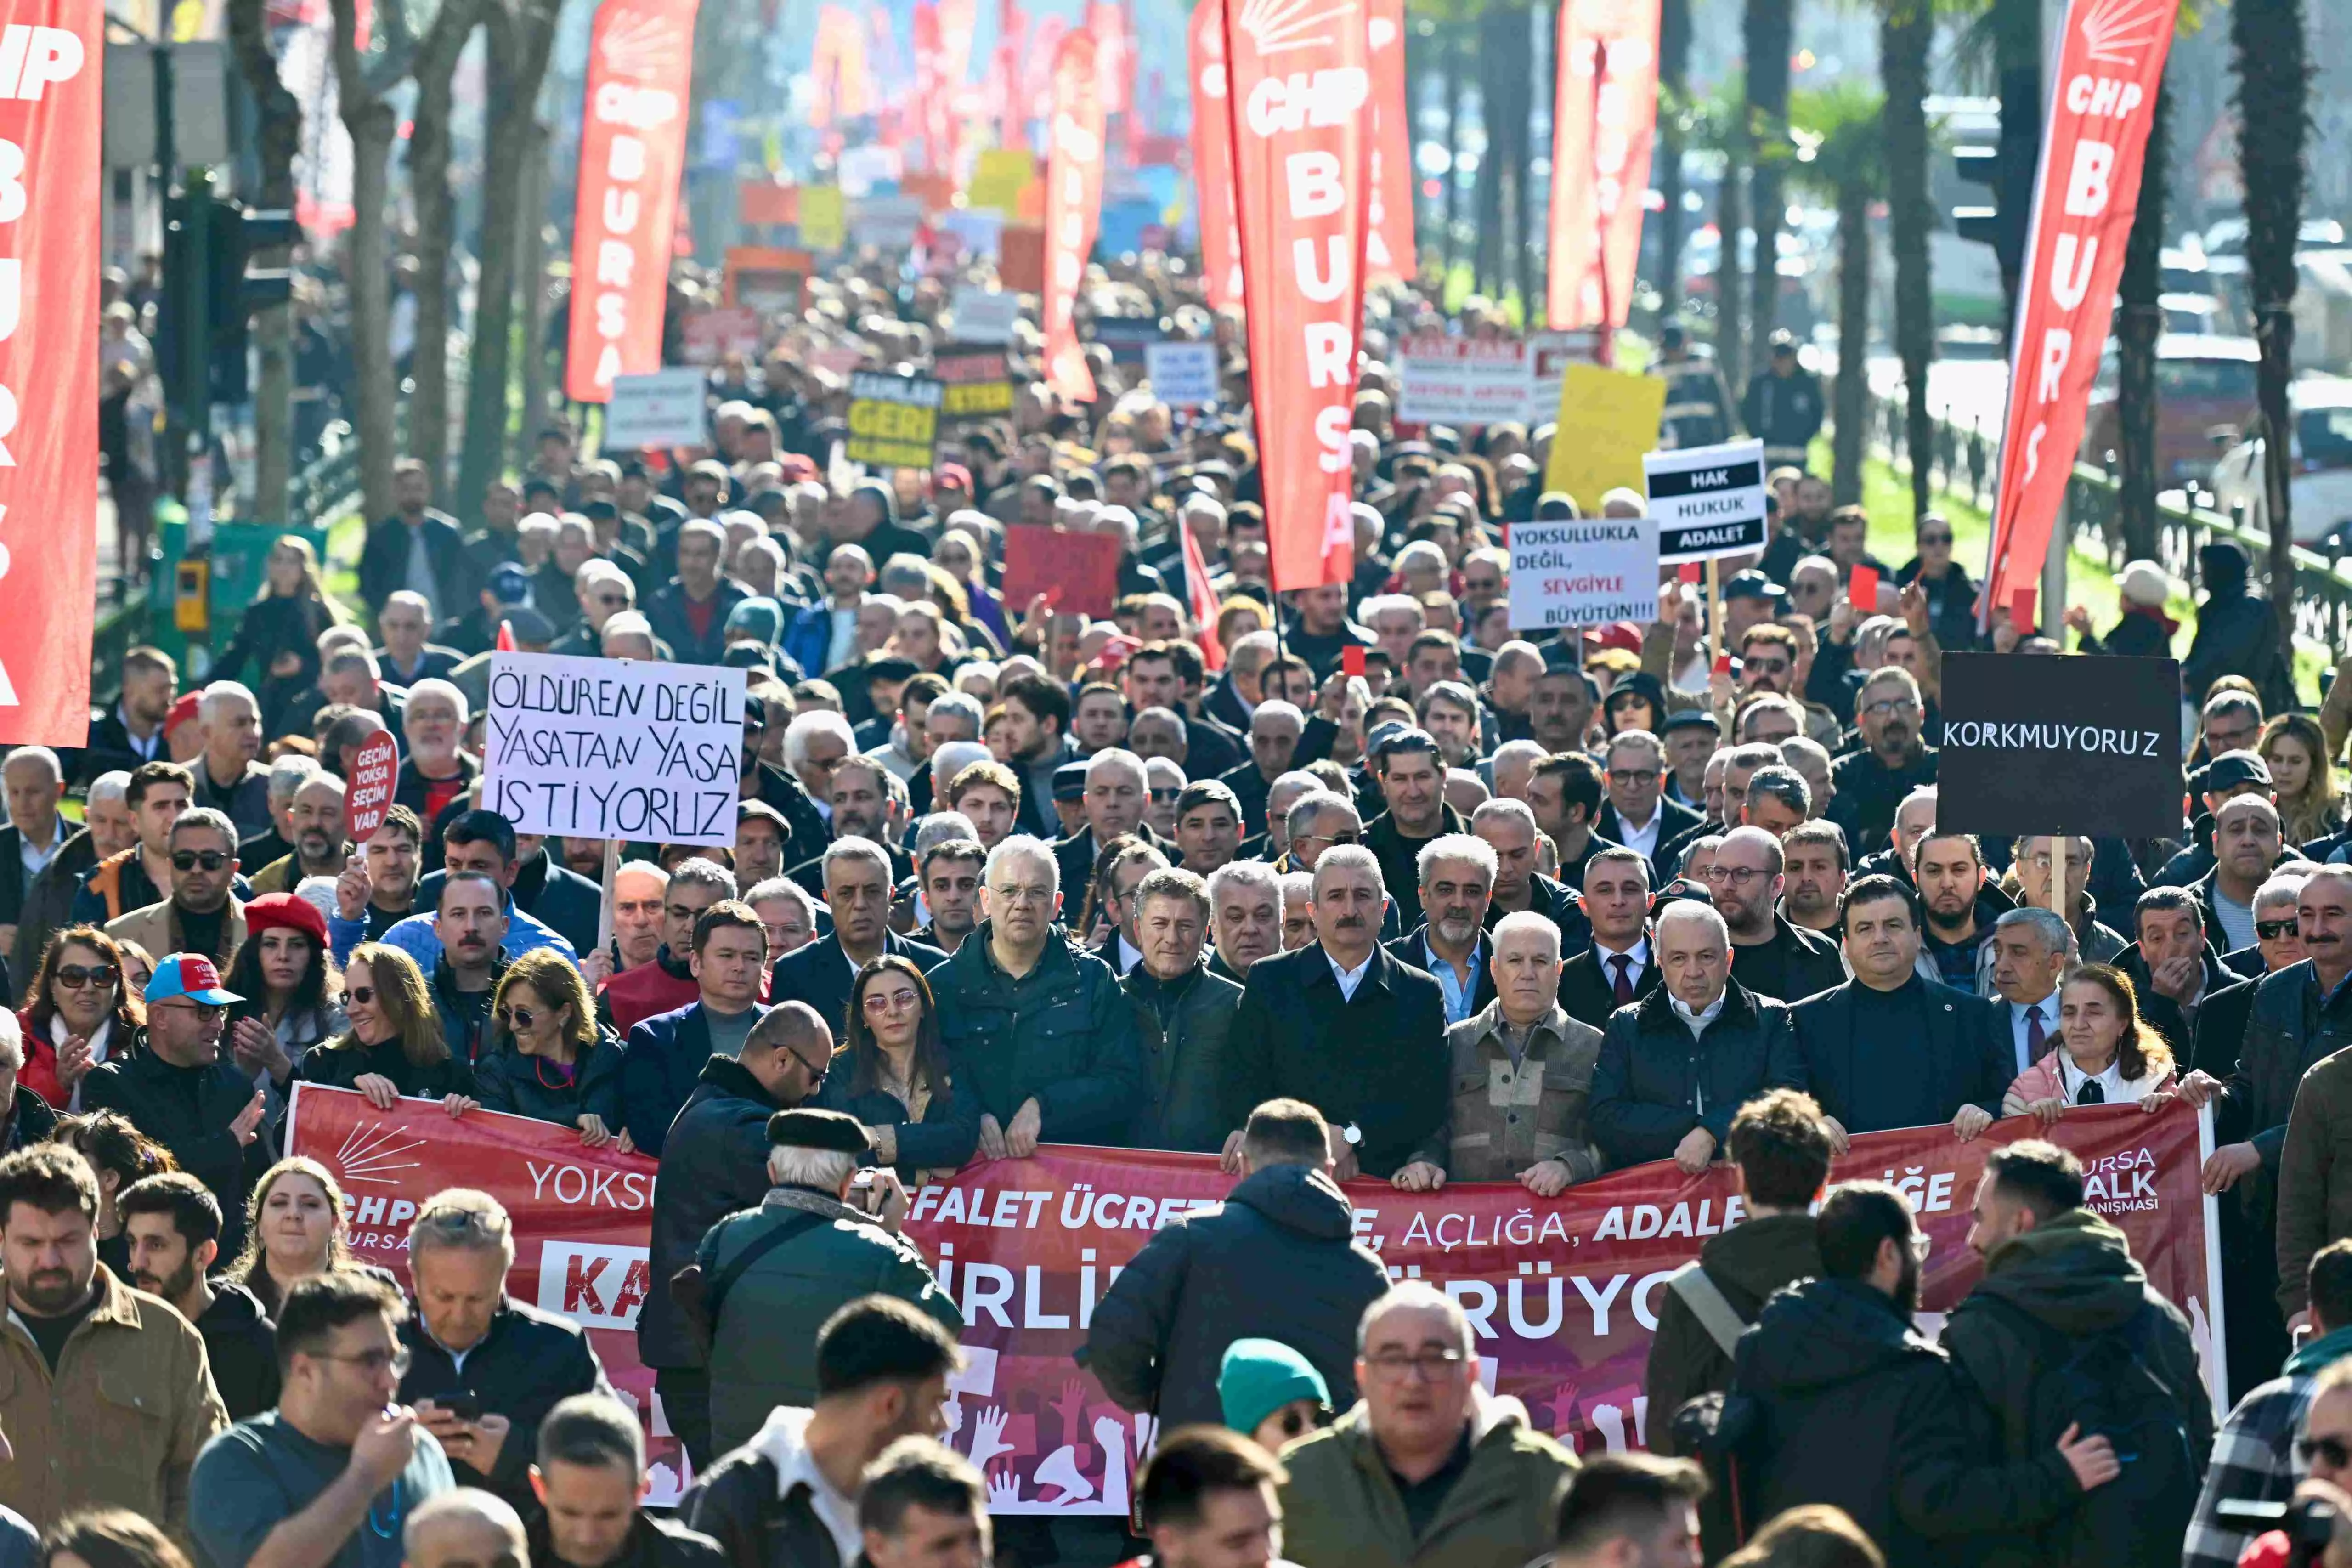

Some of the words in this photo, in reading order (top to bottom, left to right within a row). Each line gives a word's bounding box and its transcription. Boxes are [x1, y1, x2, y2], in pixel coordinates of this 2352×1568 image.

[1247, 66, 1368, 137] CHP
[2066, 74, 2143, 119] CHP
[594, 134, 645, 387] BURSA
[1285, 151, 1354, 559] BURSA
[1691, 469, 1730, 488] HAK
[1678, 496, 1745, 518] HUKUK
[1515, 525, 1639, 546] YOKSULLUKLA
[1679, 525, 1746, 548] ADALET
[1516, 549, 1572, 571] DEĞİL,
[1544, 572, 1625, 595] SEVGİYLE
[1545, 602, 1654, 624] BÜYÜTÜN!!!
[492, 665, 645, 717] ÖLDÜREN
[655, 679, 742, 725] DEĞİL
[490, 713, 641, 769] YASATAN
[648, 725, 738, 784] YASA
[1943, 721, 2160, 757] KORKMUYORUZ
[358, 742, 392, 767] GEÇİM
[356, 765, 388, 785] YOKSA
[352, 781, 387, 809] SEÇİM
[496, 775, 730, 837] İSTİYORUZ
[353, 810, 379, 832] VAR
[2080, 1148, 2156, 1177] URSA
[2083, 1170, 2158, 1201] ALK
[1402, 1207, 1580, 1253] AÇLIĞA,
[1592, 1195, 1746, 1241] ADALE
[345, 1230, 411, 1251] URSA
[937, 1242, 1125, 1329] İRLİ
